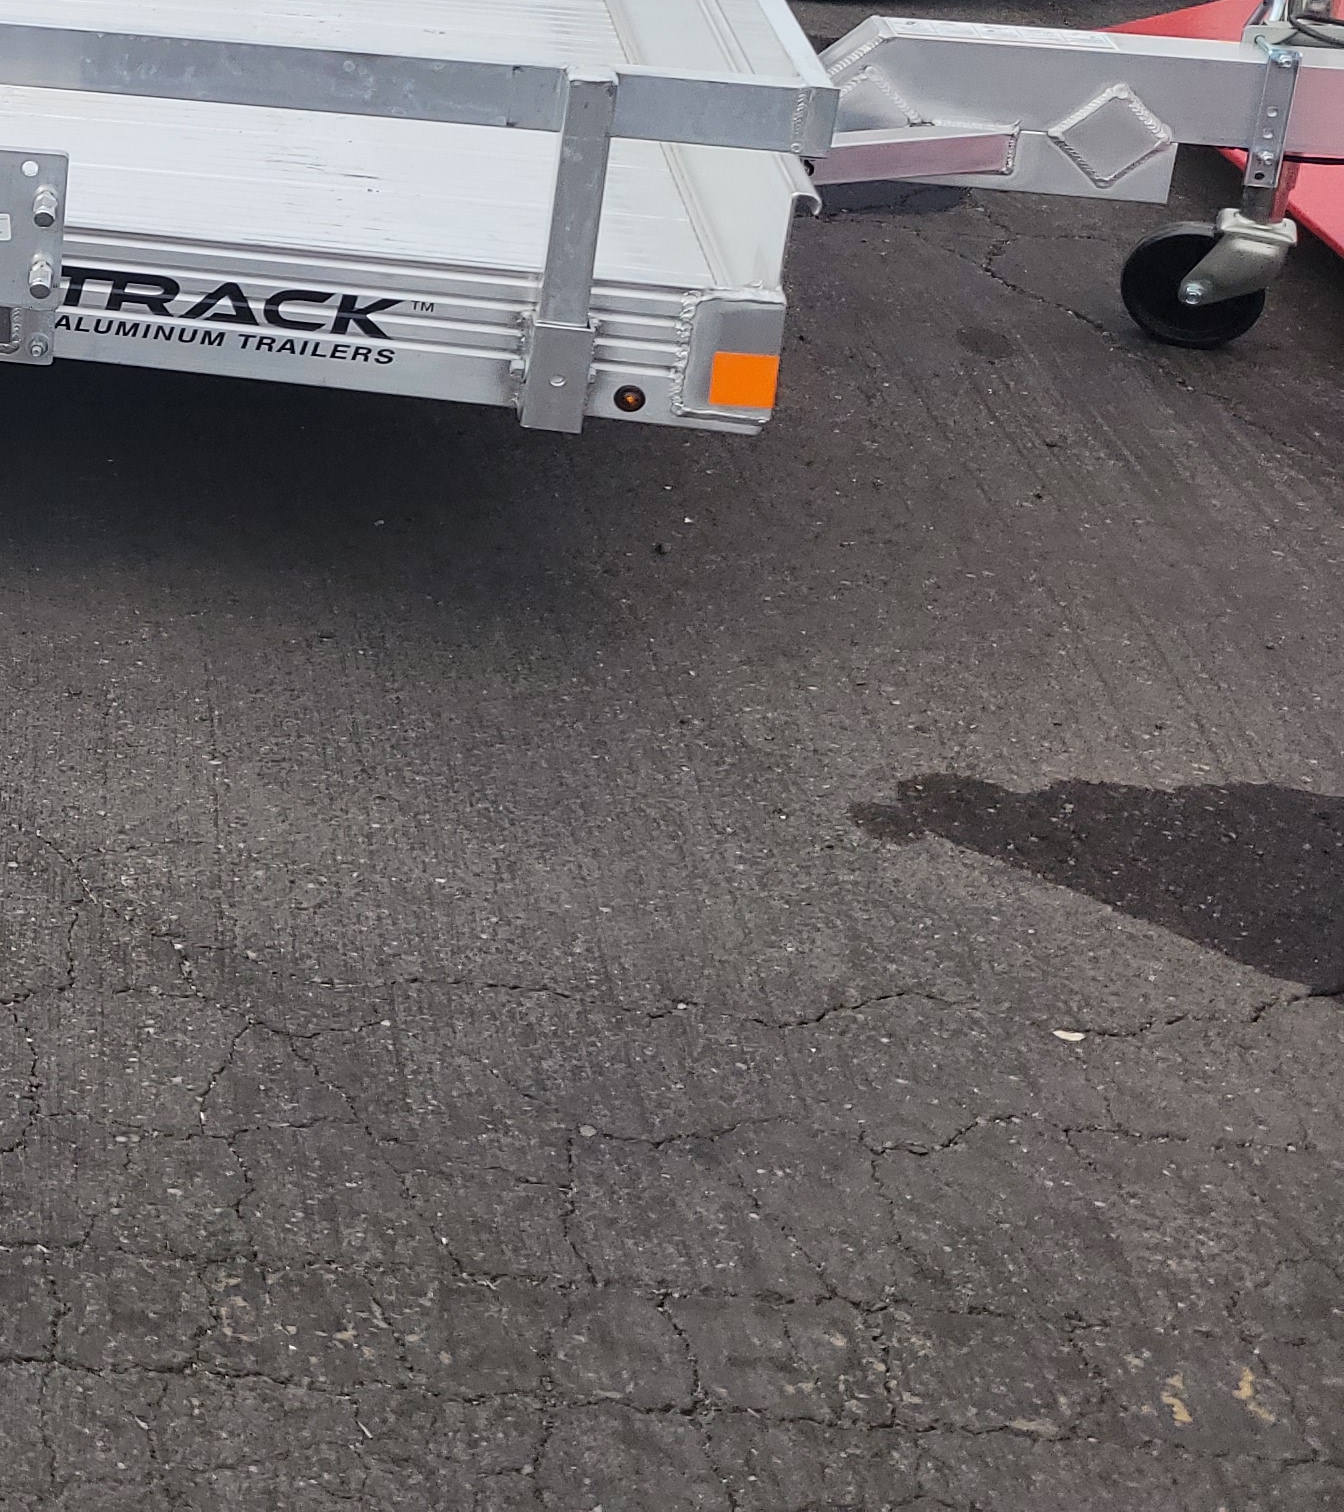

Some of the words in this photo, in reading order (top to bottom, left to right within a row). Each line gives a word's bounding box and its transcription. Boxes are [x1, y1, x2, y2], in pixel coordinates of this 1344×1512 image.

[61, 264, 406, 341] TRACK
[54, 314, 226, 348] ALUMINUM
[239, 333, 397, 366] TRAILERS
